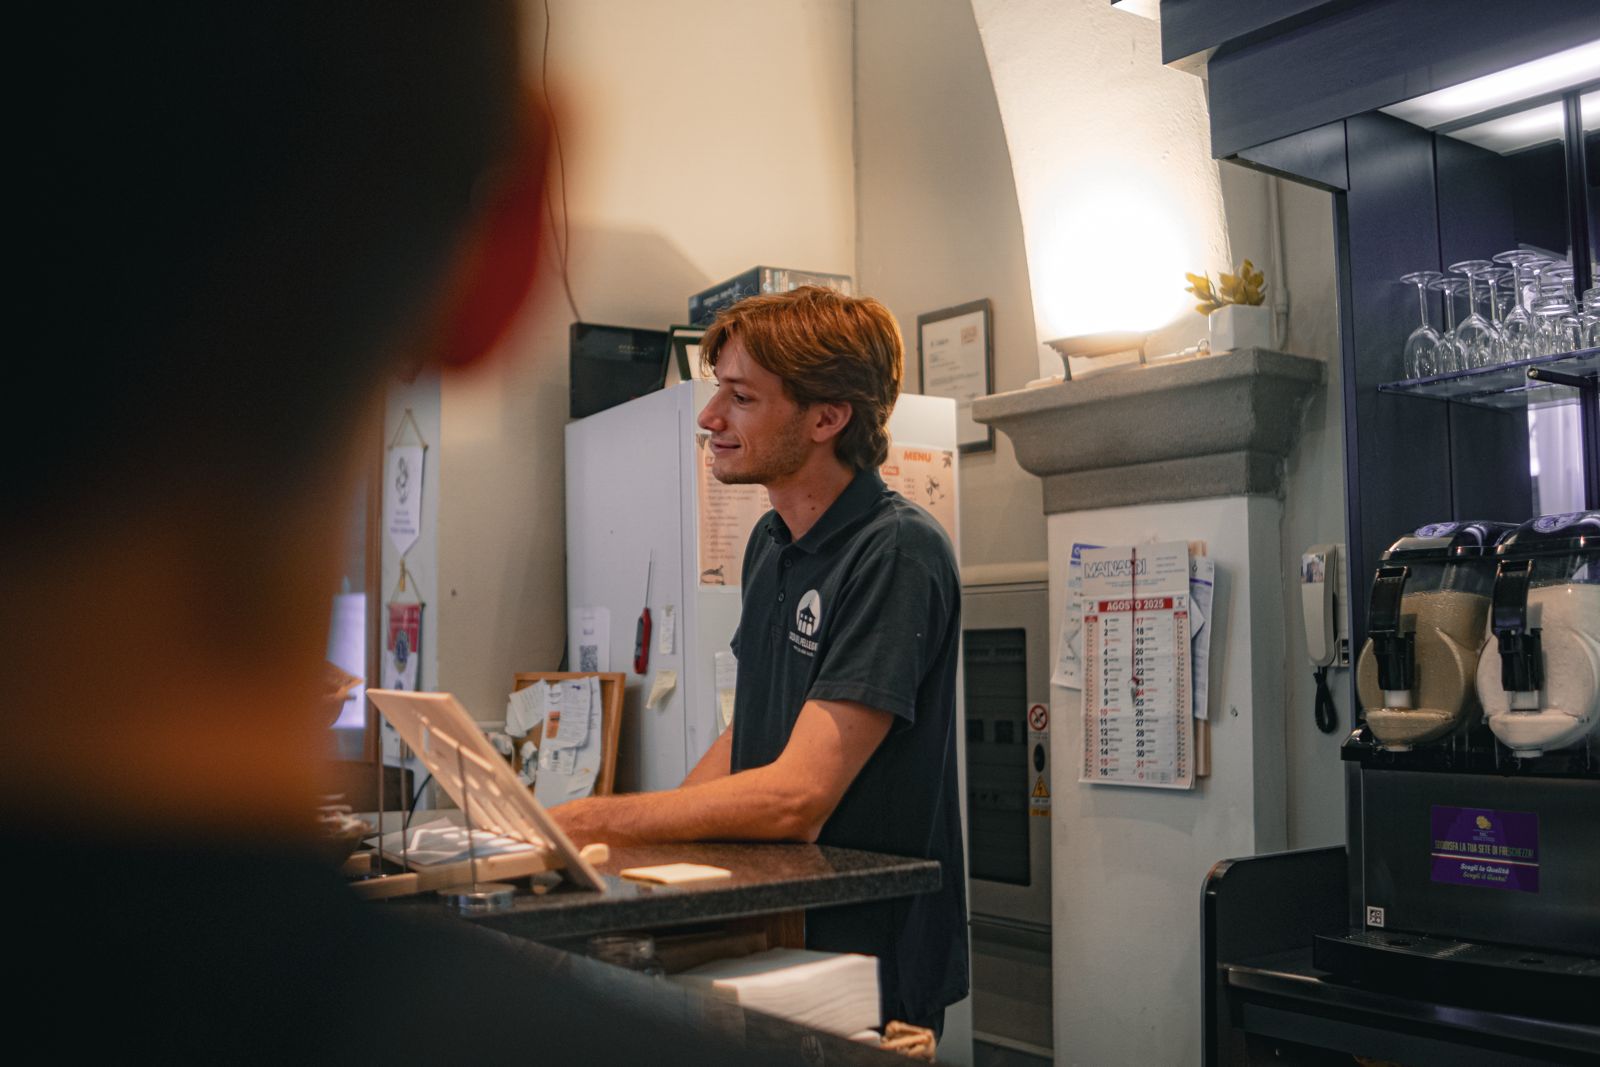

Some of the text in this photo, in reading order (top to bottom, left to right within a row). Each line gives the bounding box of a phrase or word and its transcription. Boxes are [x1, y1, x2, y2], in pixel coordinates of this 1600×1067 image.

[904, 450, 932, 463] MENU
[1143, 599, 1164, 609] 2025
[1478, 843, 1491, 854] SETE
